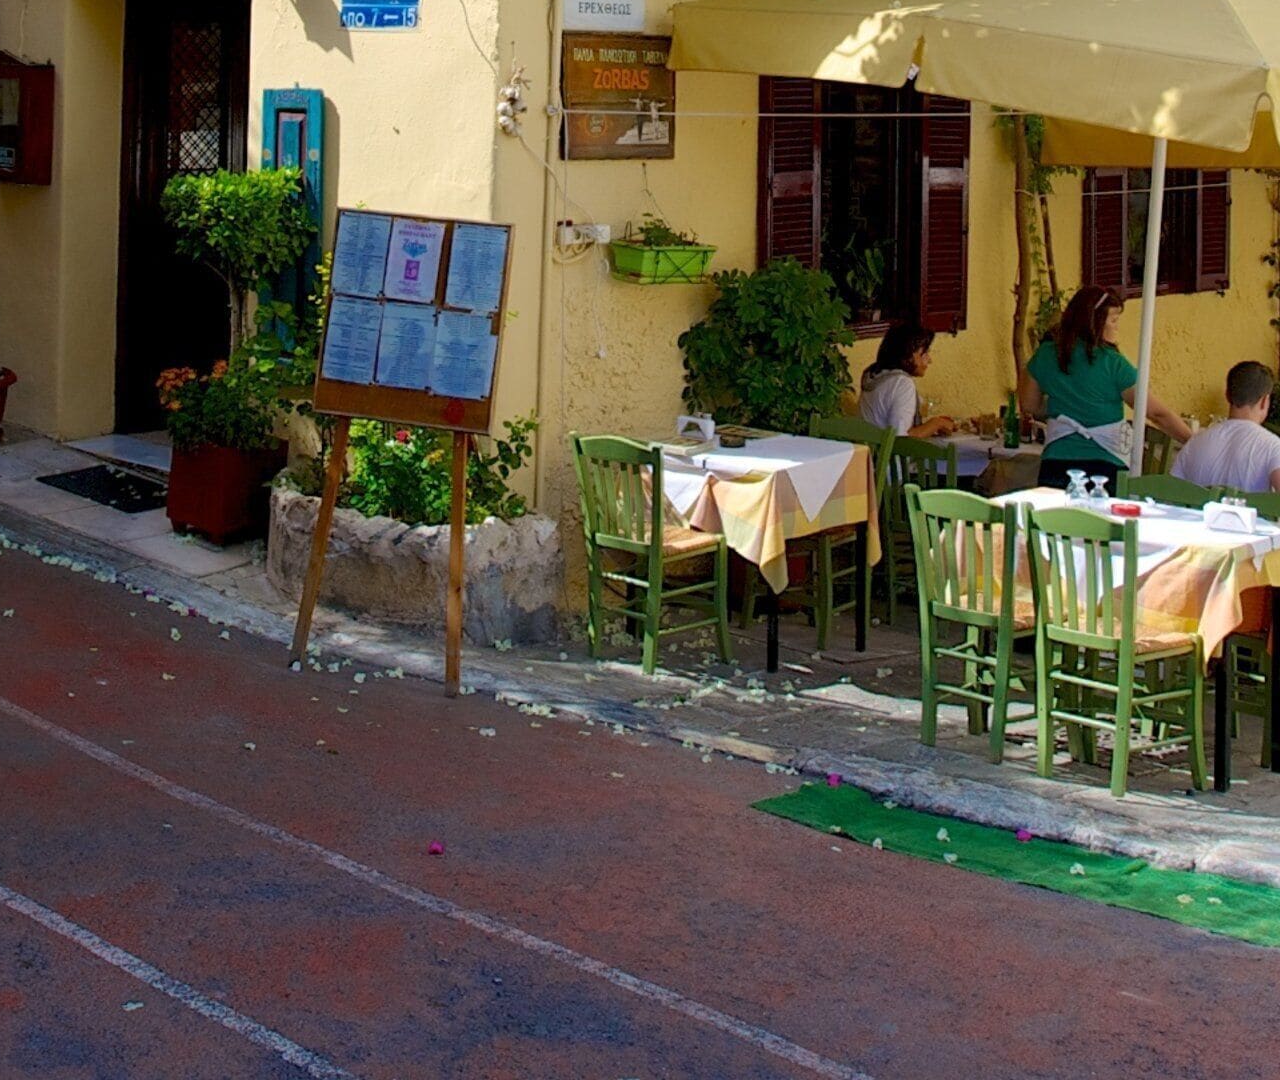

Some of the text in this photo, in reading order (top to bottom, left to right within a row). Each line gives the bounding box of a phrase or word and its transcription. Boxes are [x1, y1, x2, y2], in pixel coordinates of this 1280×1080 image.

[402, 8, 416, 27] 15
[578, 1, 632, 16] ΕΡΕΧΘΕΩΣ
[592, 68, 650, 89] ZORBAS
